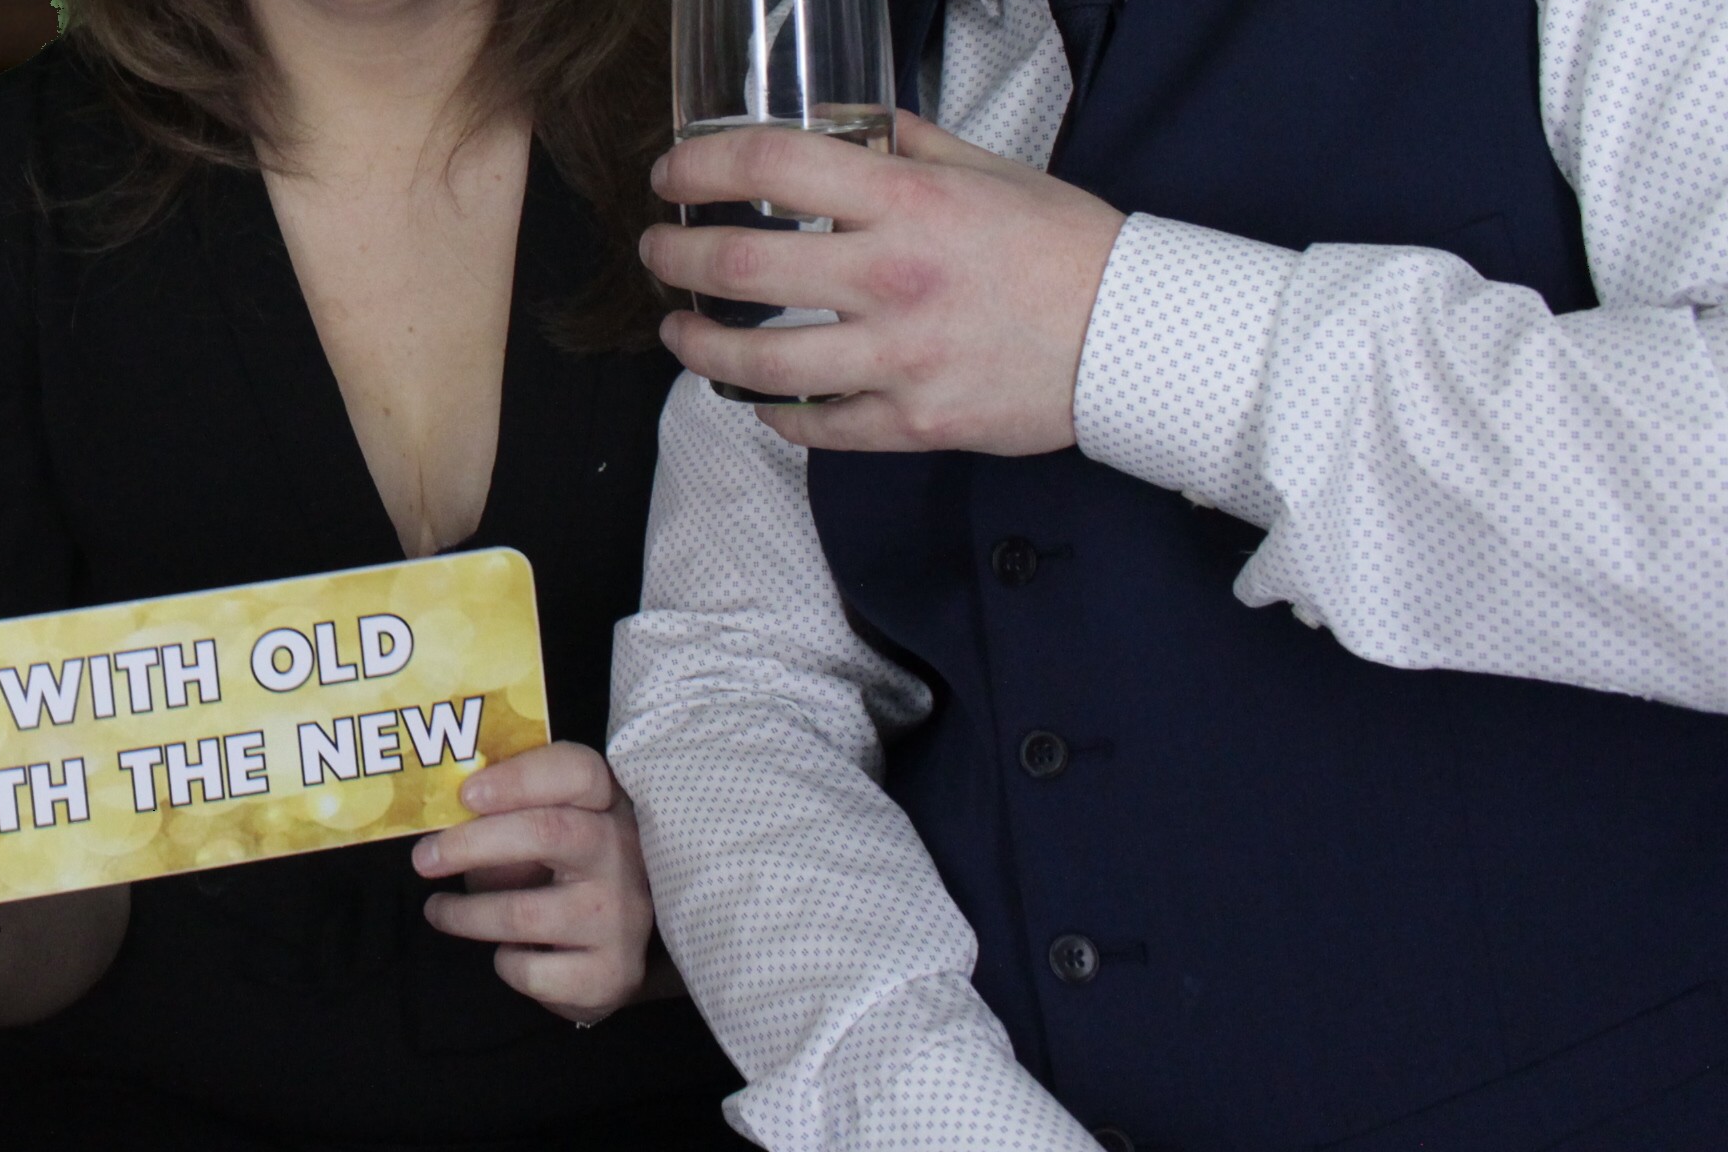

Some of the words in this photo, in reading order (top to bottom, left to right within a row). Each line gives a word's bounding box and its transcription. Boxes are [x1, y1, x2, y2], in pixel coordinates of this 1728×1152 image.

[250, 612, 414, 692] OLD
[118, 730, 269, 813] THE
[297, 695, 486, 786] NEW
